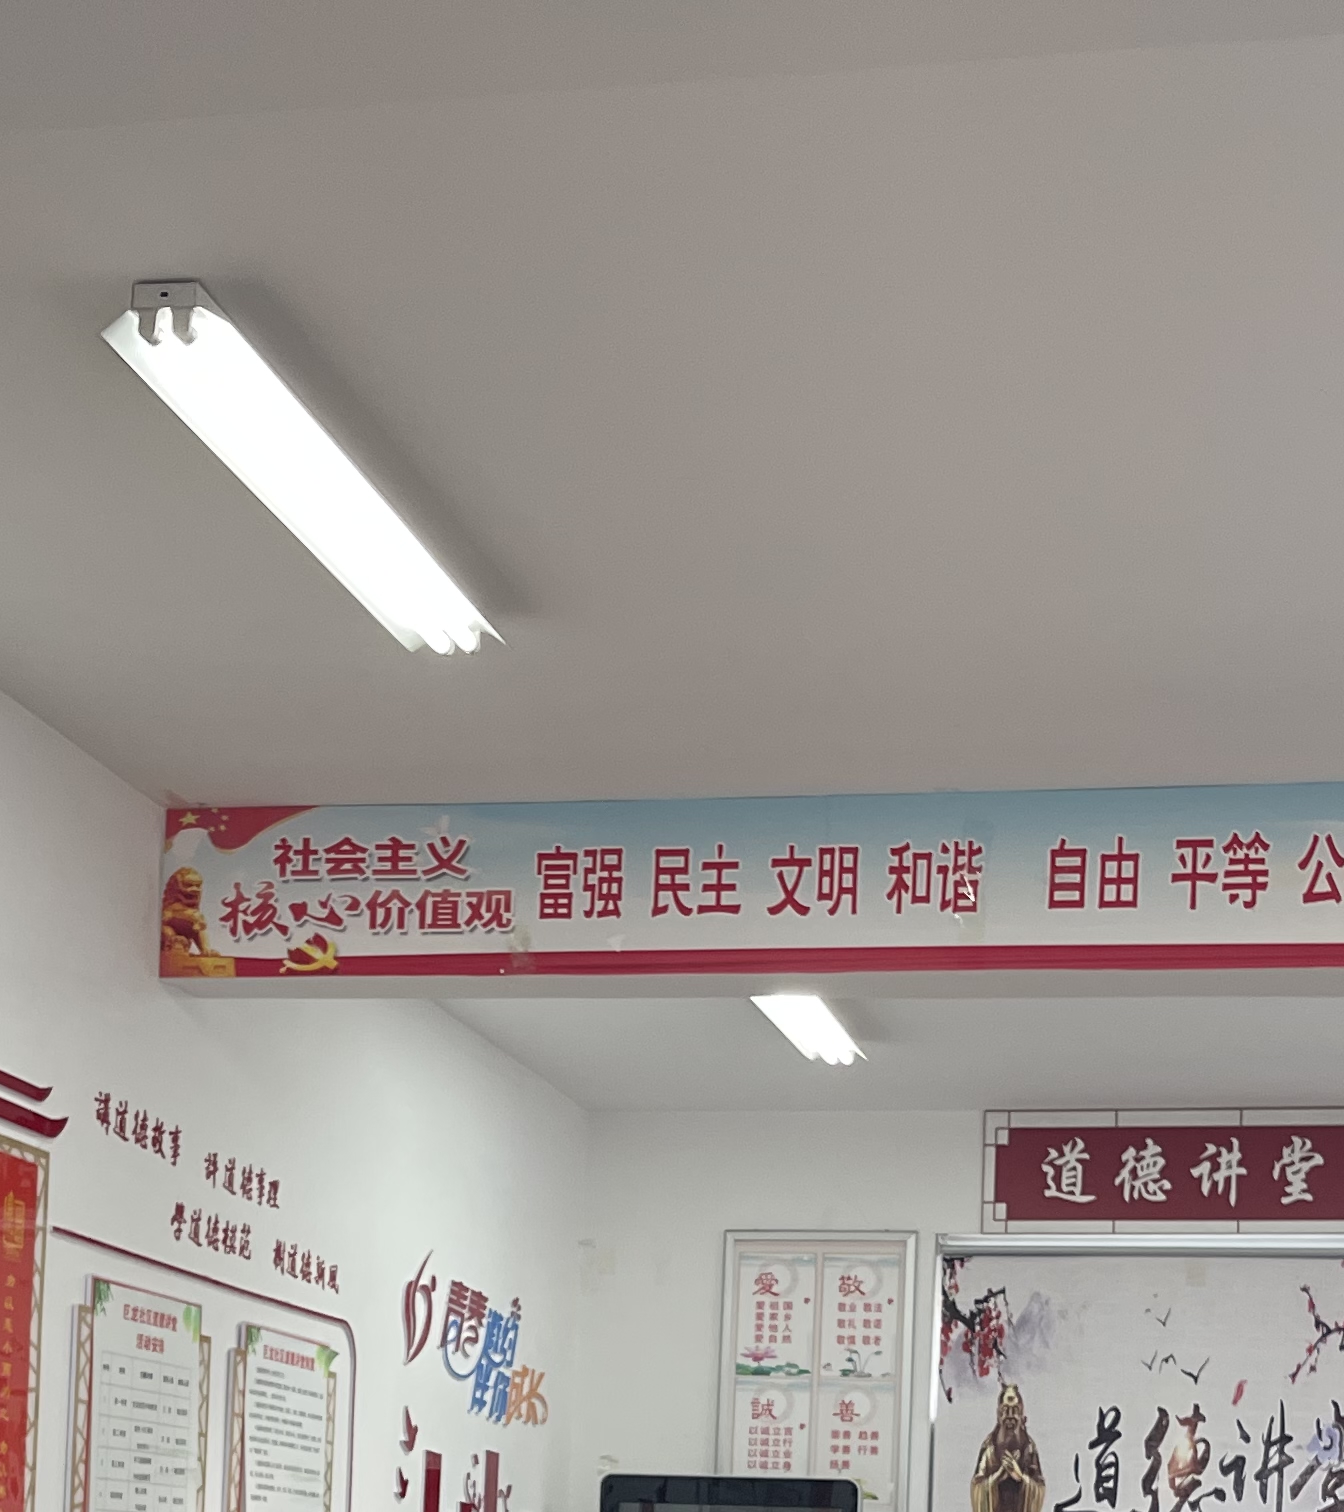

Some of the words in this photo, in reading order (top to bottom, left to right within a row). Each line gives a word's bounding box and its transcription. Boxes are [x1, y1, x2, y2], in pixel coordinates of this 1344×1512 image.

[273, 836, 472, 881] 社会主义
[535, 844, 624, 922] 富强
[650, 845, 743, 918] 民主
[766, 842, 861, 918] 文明
[886, 838, 984, 916] 和谐
[1046, 835, 1141, 912] 自由
[1169, 830, 1271, 911] 平等
[219, 880, 514, 939] 核心价值观
[1042, 1135, 1326, 1207] 道德讲堂
[839, 1275, 866, 1297] 敬
